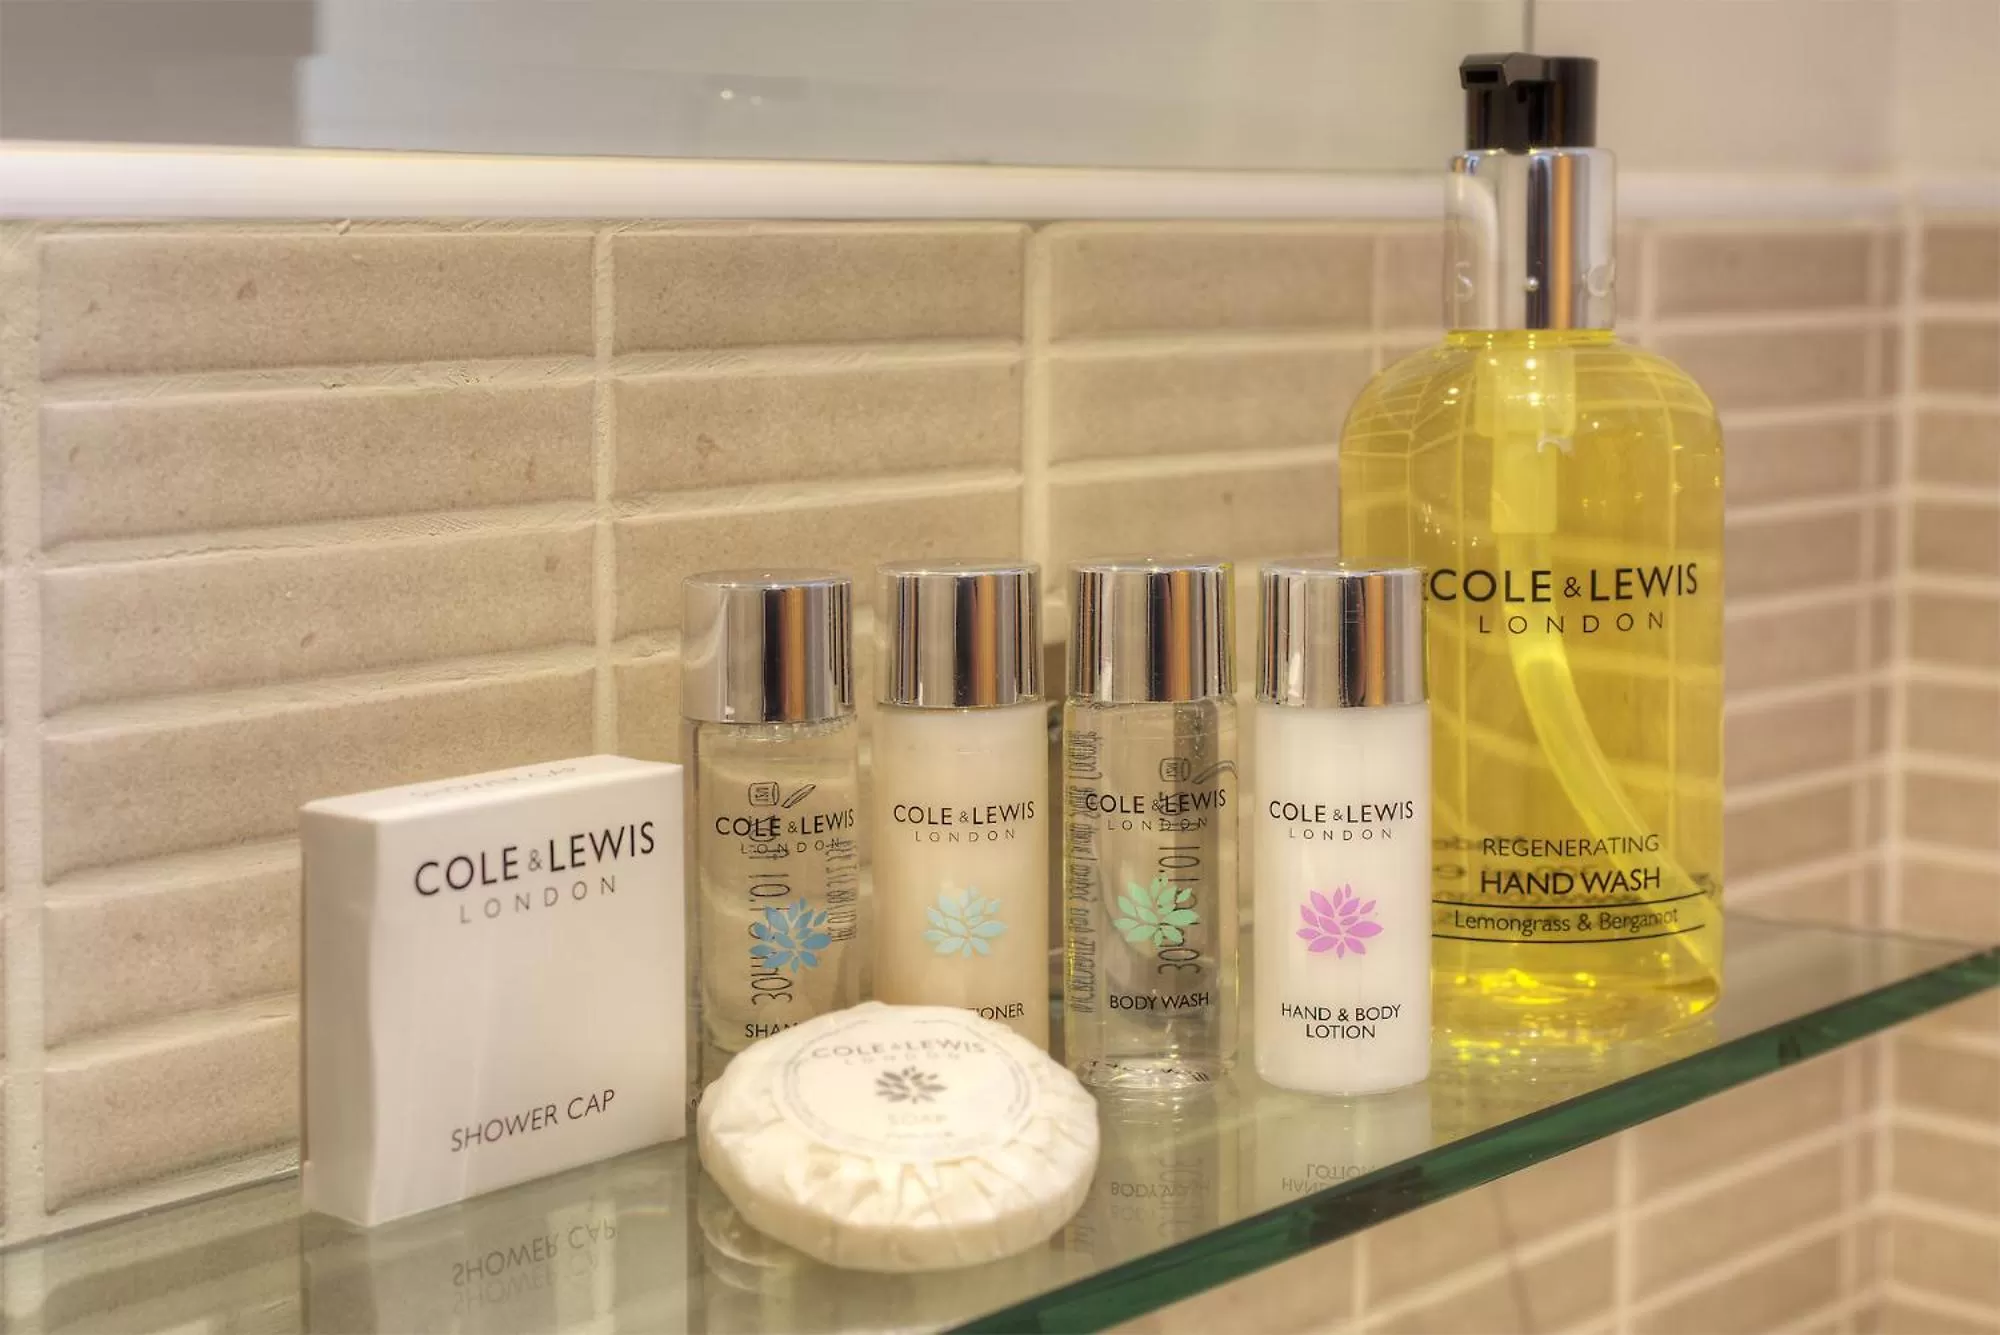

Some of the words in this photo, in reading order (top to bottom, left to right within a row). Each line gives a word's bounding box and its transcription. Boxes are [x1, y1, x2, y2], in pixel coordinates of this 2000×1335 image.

[1430, 568, 1552, 603] COLE
[1563, 576, 1582, 598] &
[1590, 563, 1698, 602] LEWIS
[1479, 612, 1664, 634] LONDON
[893, 804, 953, 826] COLE
[959, 810, 970, 824] &
[972, 800, 1035, 826] LEWIS
[1085, 794, 1145, 814] COLE
[1151, 799, 1164, 812] &
[1164, 789, 1227, 813] LEWIS
[1269, 800, 1327, 824] COLE
[1332, 809, 1344, 822] &
[1346, 800, 1414, 824] LEWIS
[715, 816, 781, 837] COLE
[787, 820, 798, 834] &
[801, 808, 855, 836] LEWIS
[1107, 818, 1208, 831] LONDON
[1288, 827, 1393, 841] LONDON
[740, 837, 841, 855] LONDON
[915, 828, 1016, 843] LONDON
[1482, 834, 1660, 857] REGENERATING
[415, 845, 520, 896] COLE
[527, 848, 543, 872] &
[549, 821, 655, 873] LEWIS
[1480, 870, 1574, 895] HAND
[1580, 866, 1661, 894] WASH
[460, 875, 616, 924] LONDON
[1454, 909, 1571, 937] Lemongrass
[1577, 912, 1593, 932] &
[1600, 908, 1678, 933] Bergamot
[965, 1003, 1025, 1020] ONER
[1109, 995, 1160, 1011] BODY
[1161, 991, 1210, 1010] WASH
[1281, 1002, 1332, 1022] HAND
[1337, 1008, 1350, 1022] &
[1354, 1004, 1401, 1022] BODY
[1305, 1023, 1376, 1039] LOTION
[812, 1043, 886, 1059] COLE
[900, 1038, 987, 1054] LEWIS
[450, 1104, 558, 1153] SHOWER
[567, 1088, 616, 1121] CAP
